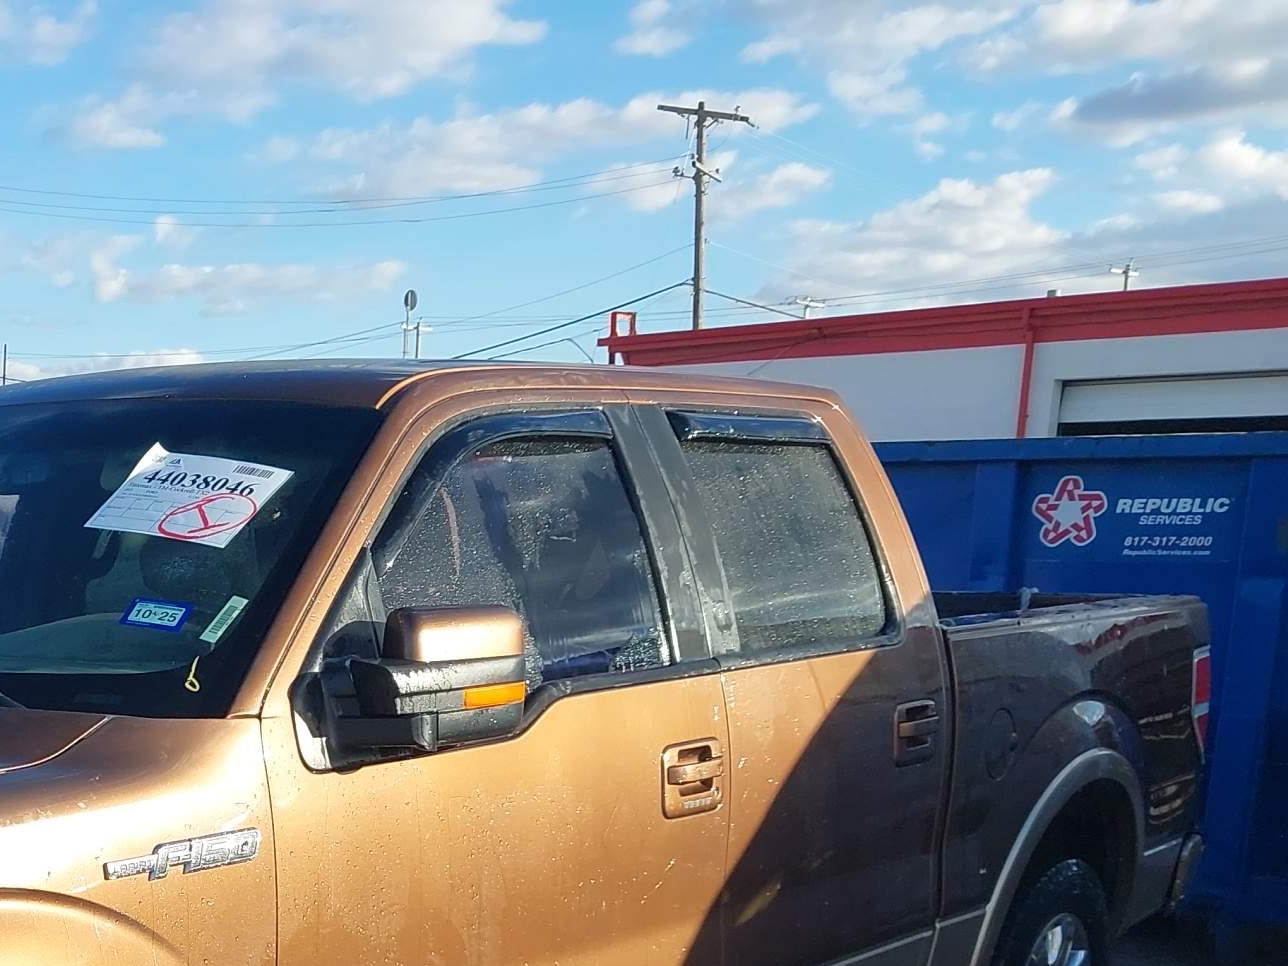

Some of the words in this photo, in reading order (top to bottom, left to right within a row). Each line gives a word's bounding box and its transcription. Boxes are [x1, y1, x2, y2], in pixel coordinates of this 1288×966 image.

[144, 469, 260, 497] 44038046
[1115, 497, 1231, 514] REPUBLIC
[1138, 515, 1203, 525] SERVICES
[1123, 536, 1213, 547] 817-317-2000
[134, 608, 153, 619] 10
[158, 611, 179, 623] 25
